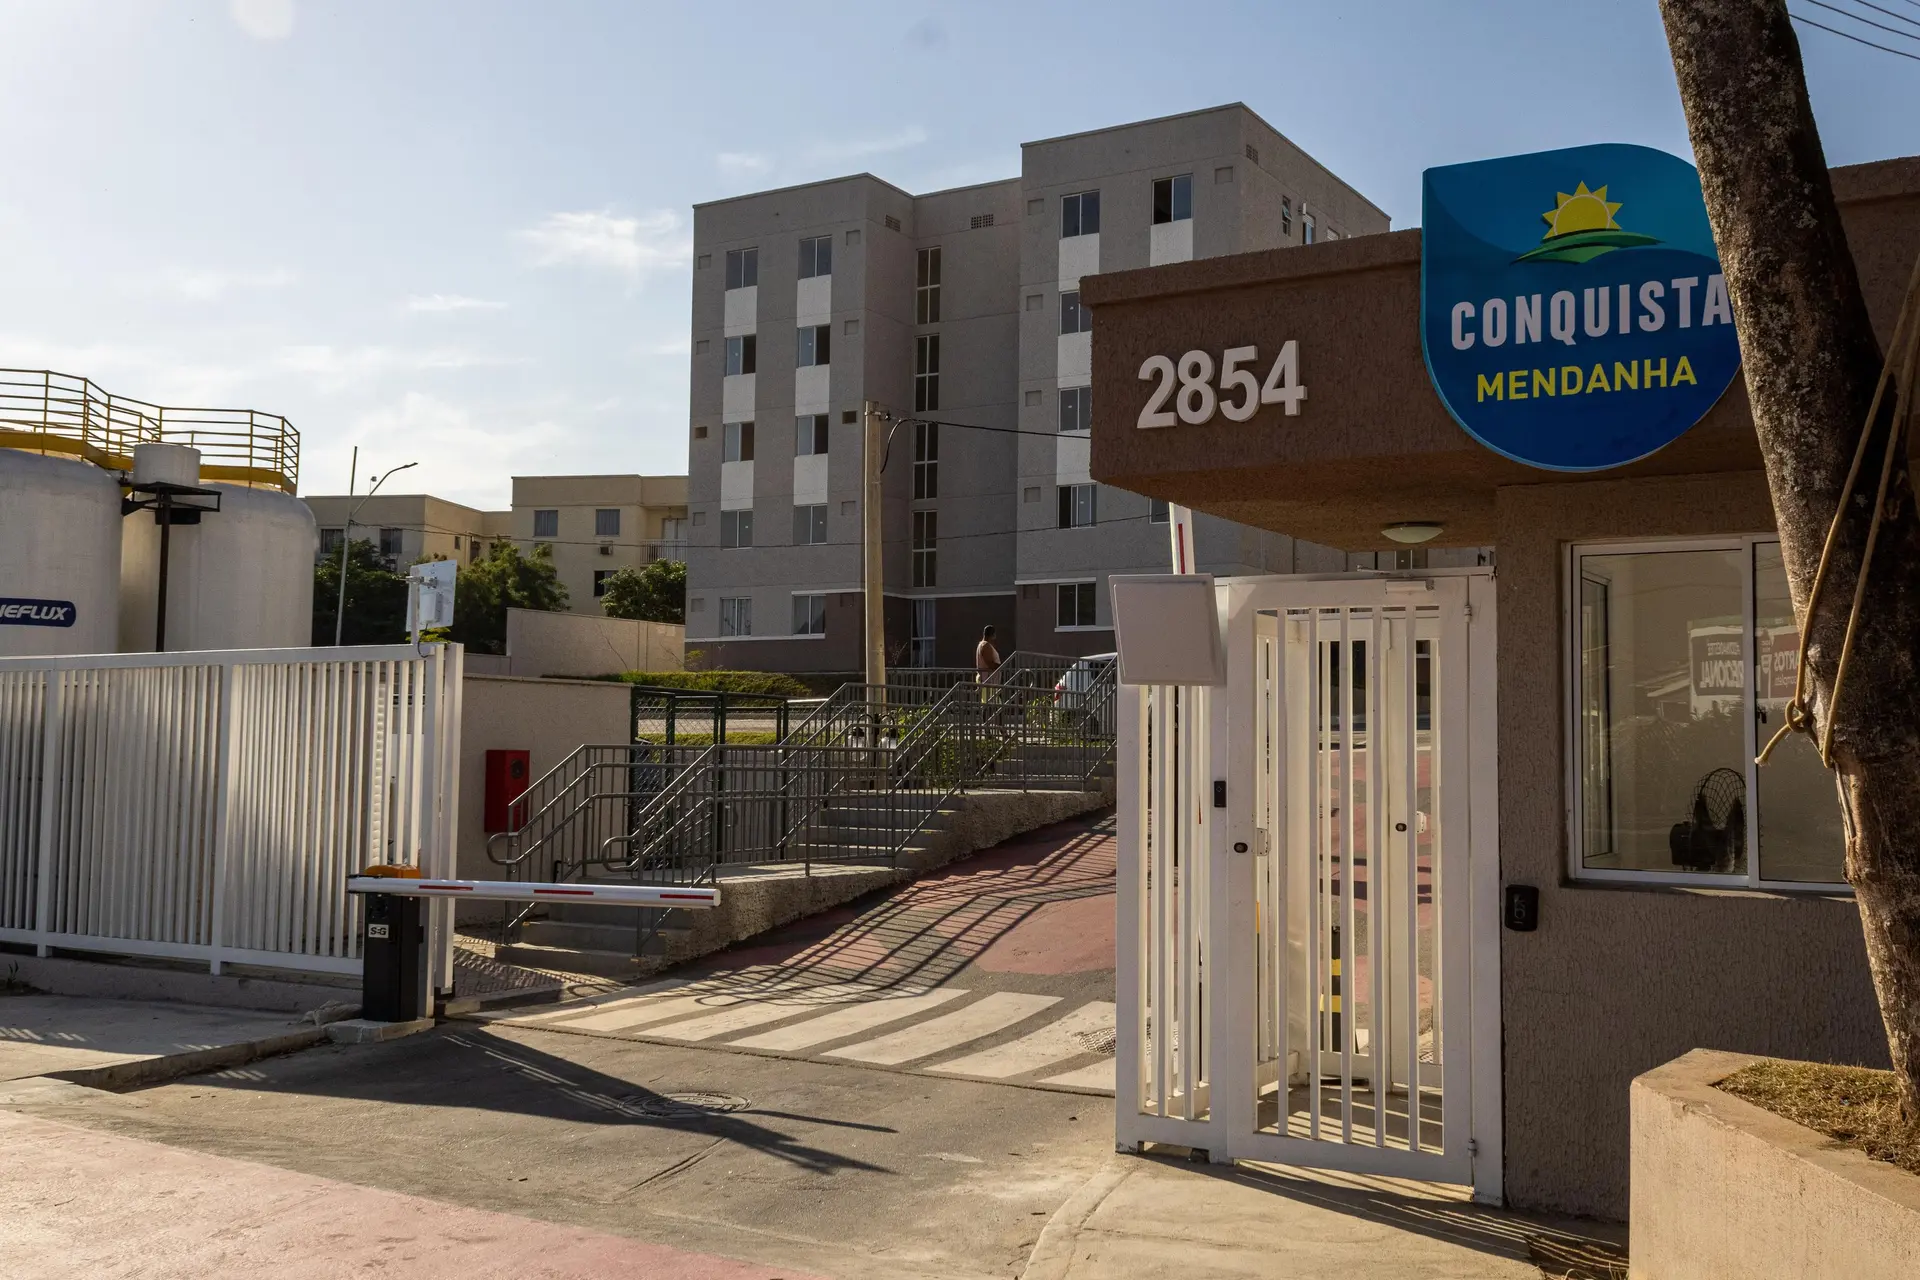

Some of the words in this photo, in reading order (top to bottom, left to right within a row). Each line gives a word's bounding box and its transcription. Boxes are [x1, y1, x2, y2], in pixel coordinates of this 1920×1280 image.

[1451, 273, 1731, 350] CONQUISTA
[1136, 339, 1308, 429] 2854
[1477, 355, 1698, 403] MENDANHA
